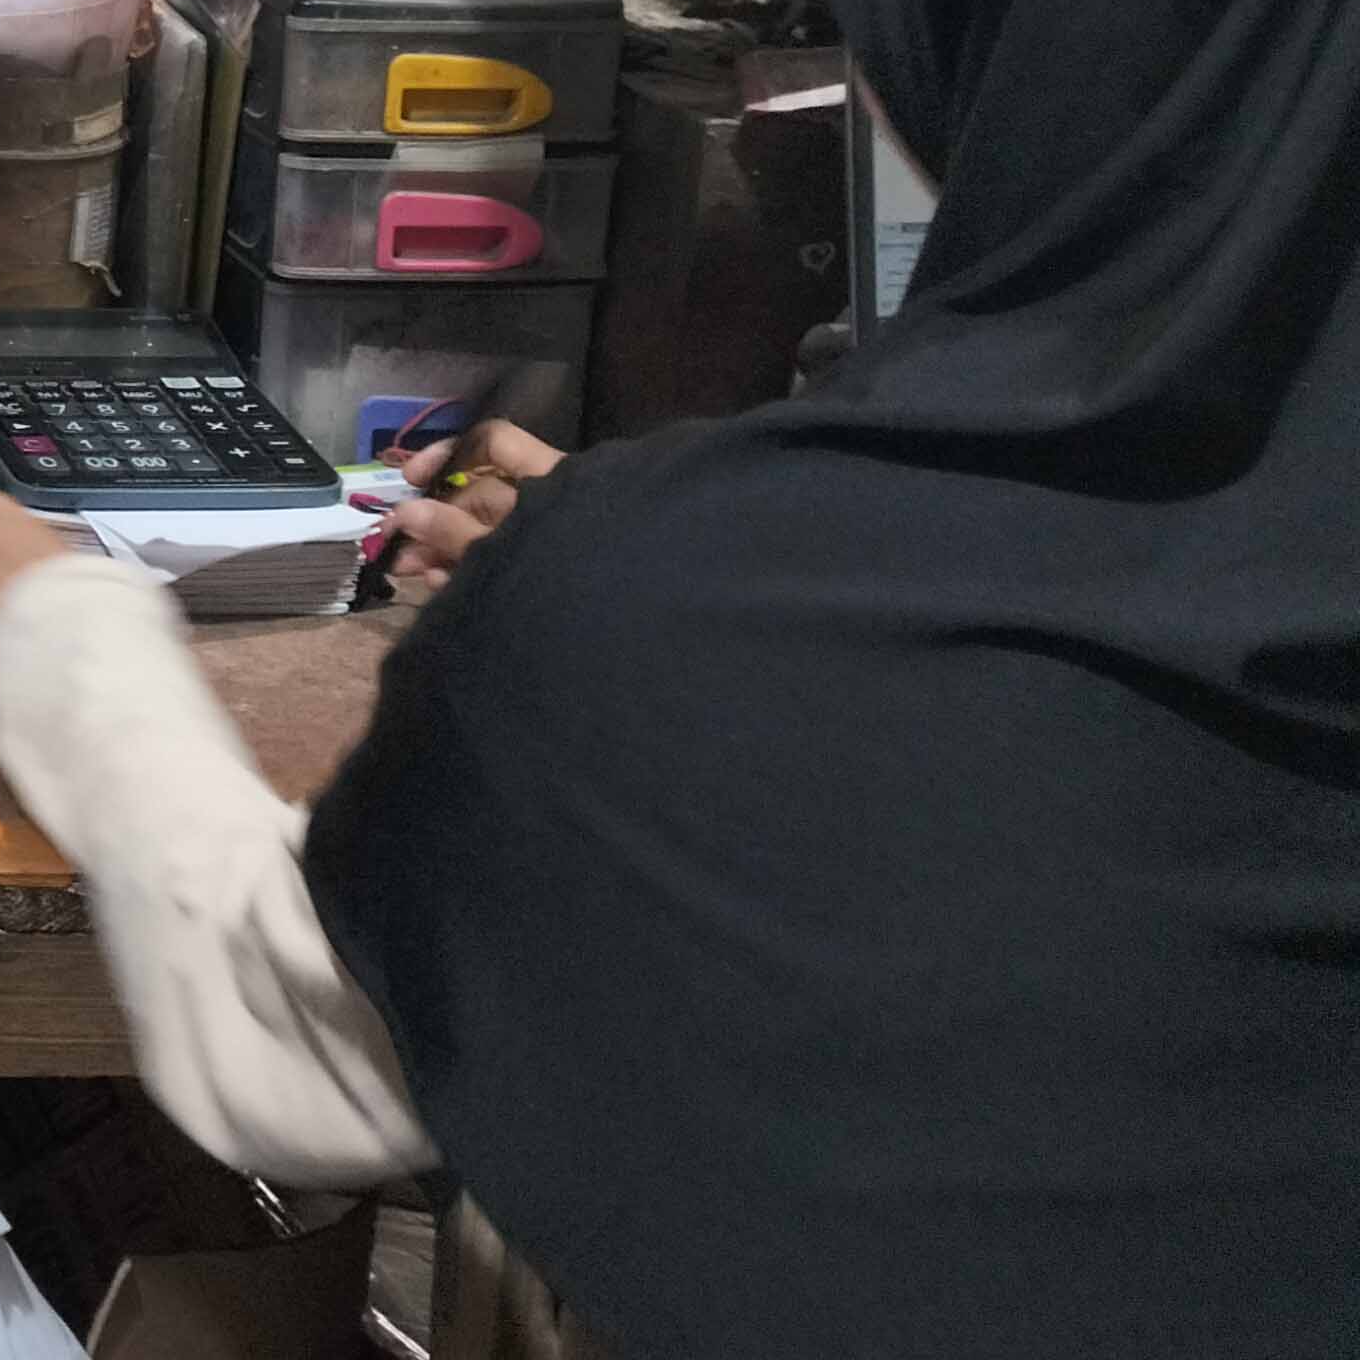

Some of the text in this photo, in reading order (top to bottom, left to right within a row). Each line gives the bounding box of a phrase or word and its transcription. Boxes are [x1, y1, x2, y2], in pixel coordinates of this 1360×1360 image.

[51, 404, 66, 415] 7
[97, 403, 116, 415] 8
[142, 404, 159, 414] 9
[67, 421, 84, 432] 4
[111, 421, 130, 432] 5
[158, 421, 176, 432] 6
[125, 439, 145, 450] 2
